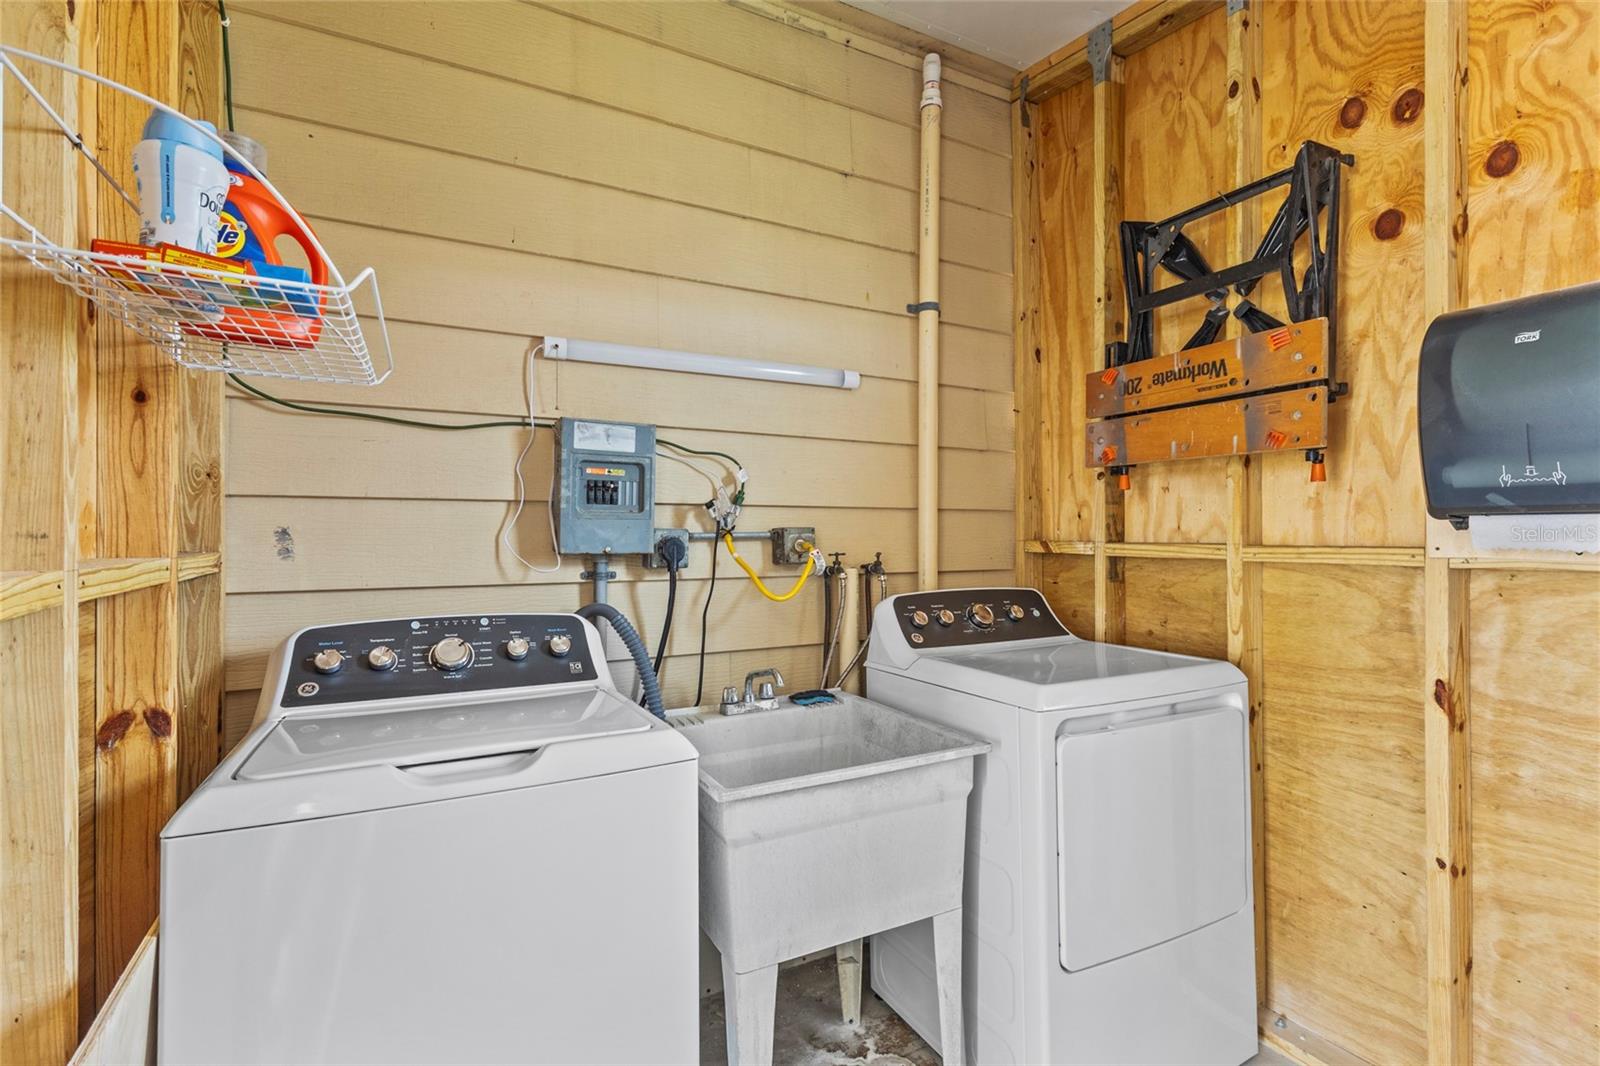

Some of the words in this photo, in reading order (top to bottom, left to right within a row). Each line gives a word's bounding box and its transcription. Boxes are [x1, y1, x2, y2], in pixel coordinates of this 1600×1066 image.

[1515, 333, 1540, 343] TORK
[1152, 358, 1228, 386] Workmate
[1119, 376, 1142, 396] 200
